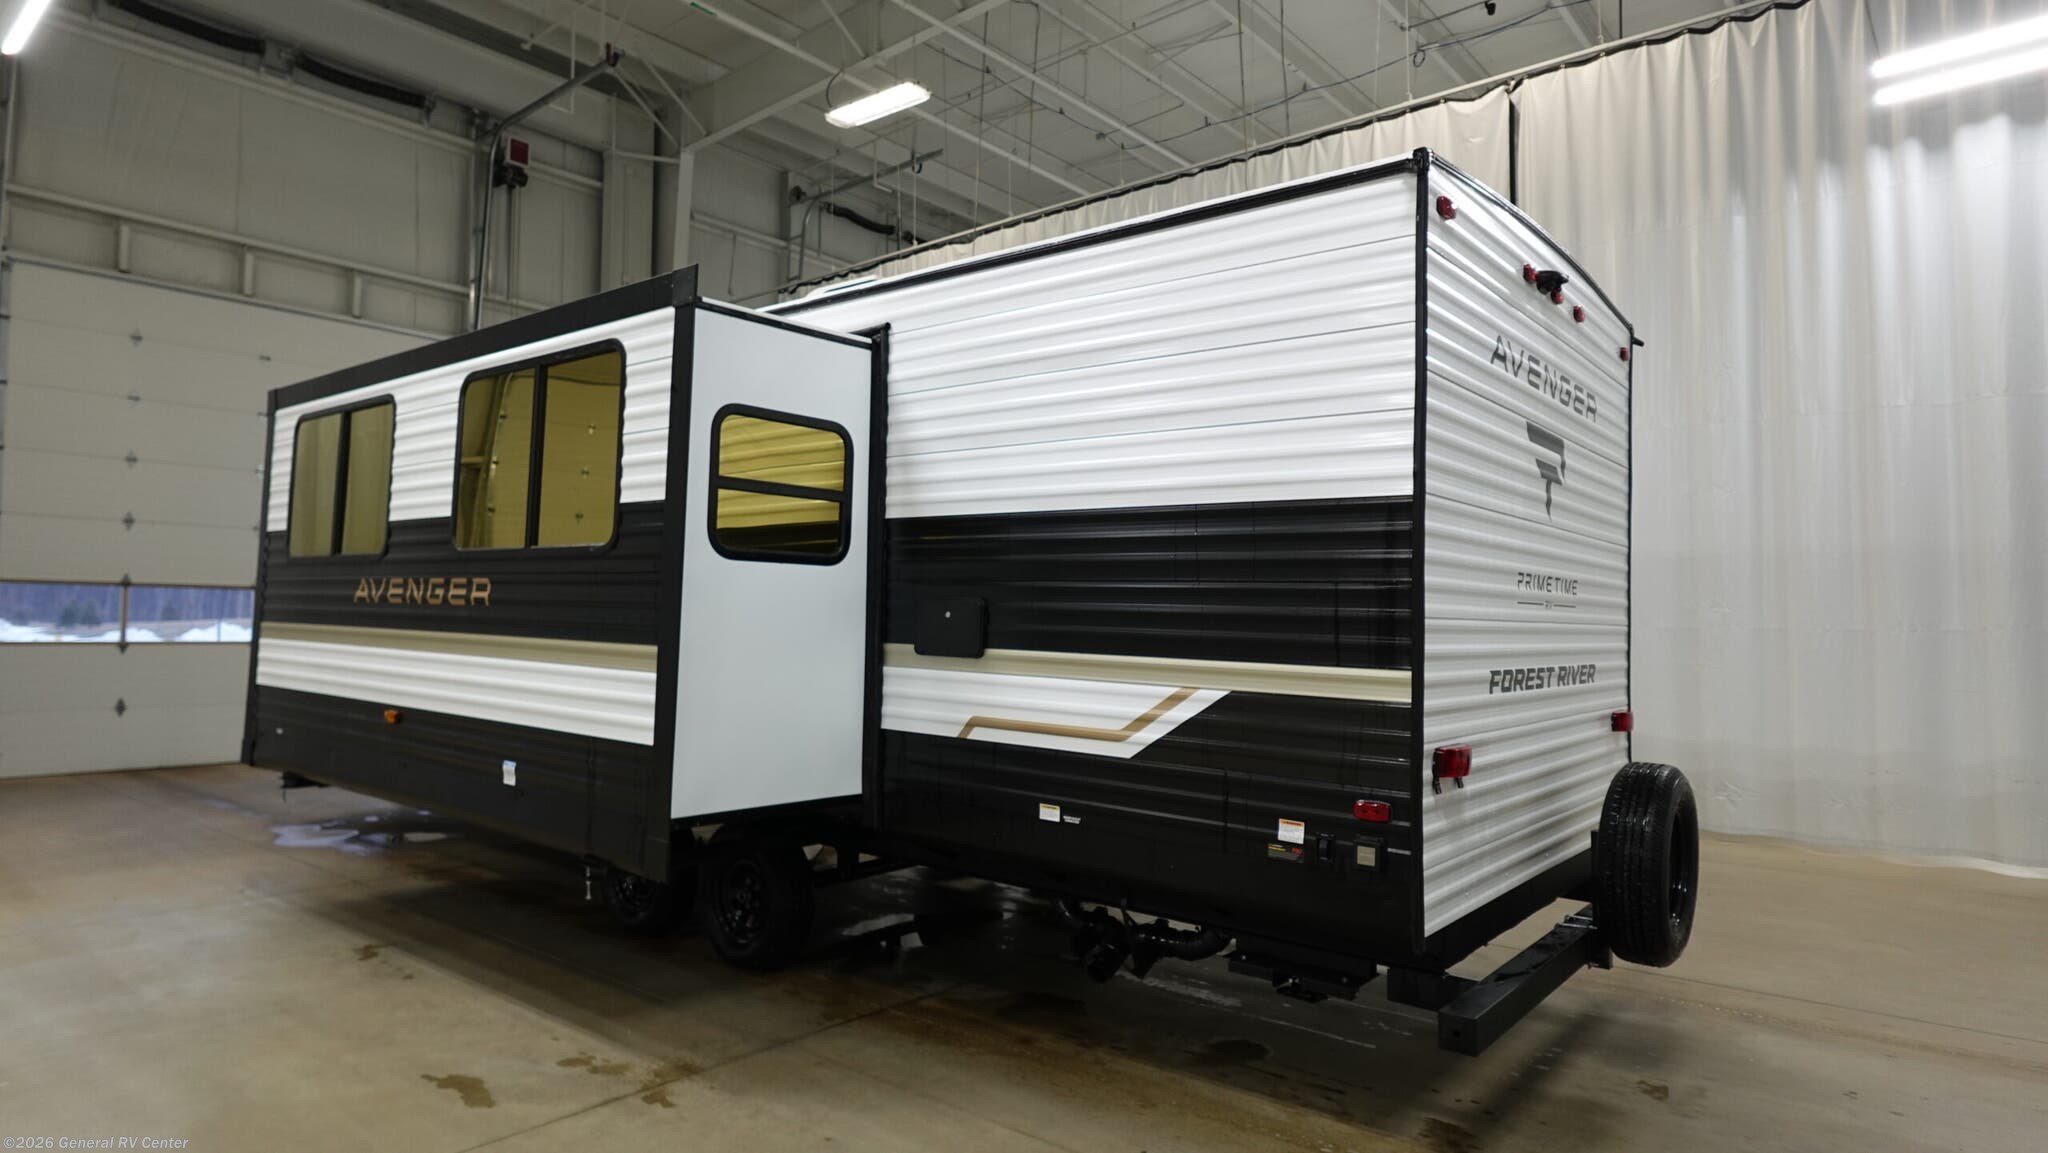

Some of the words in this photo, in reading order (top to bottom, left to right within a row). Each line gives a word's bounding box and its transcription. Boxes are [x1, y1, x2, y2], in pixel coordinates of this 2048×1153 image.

[1490, 335, 1597, 423] AVENGER
[353, 577, 492, 606] AVENGER
[1489, 667, 1556, 694] FOREST
[1557, 664, 1597, 687] RIVER
